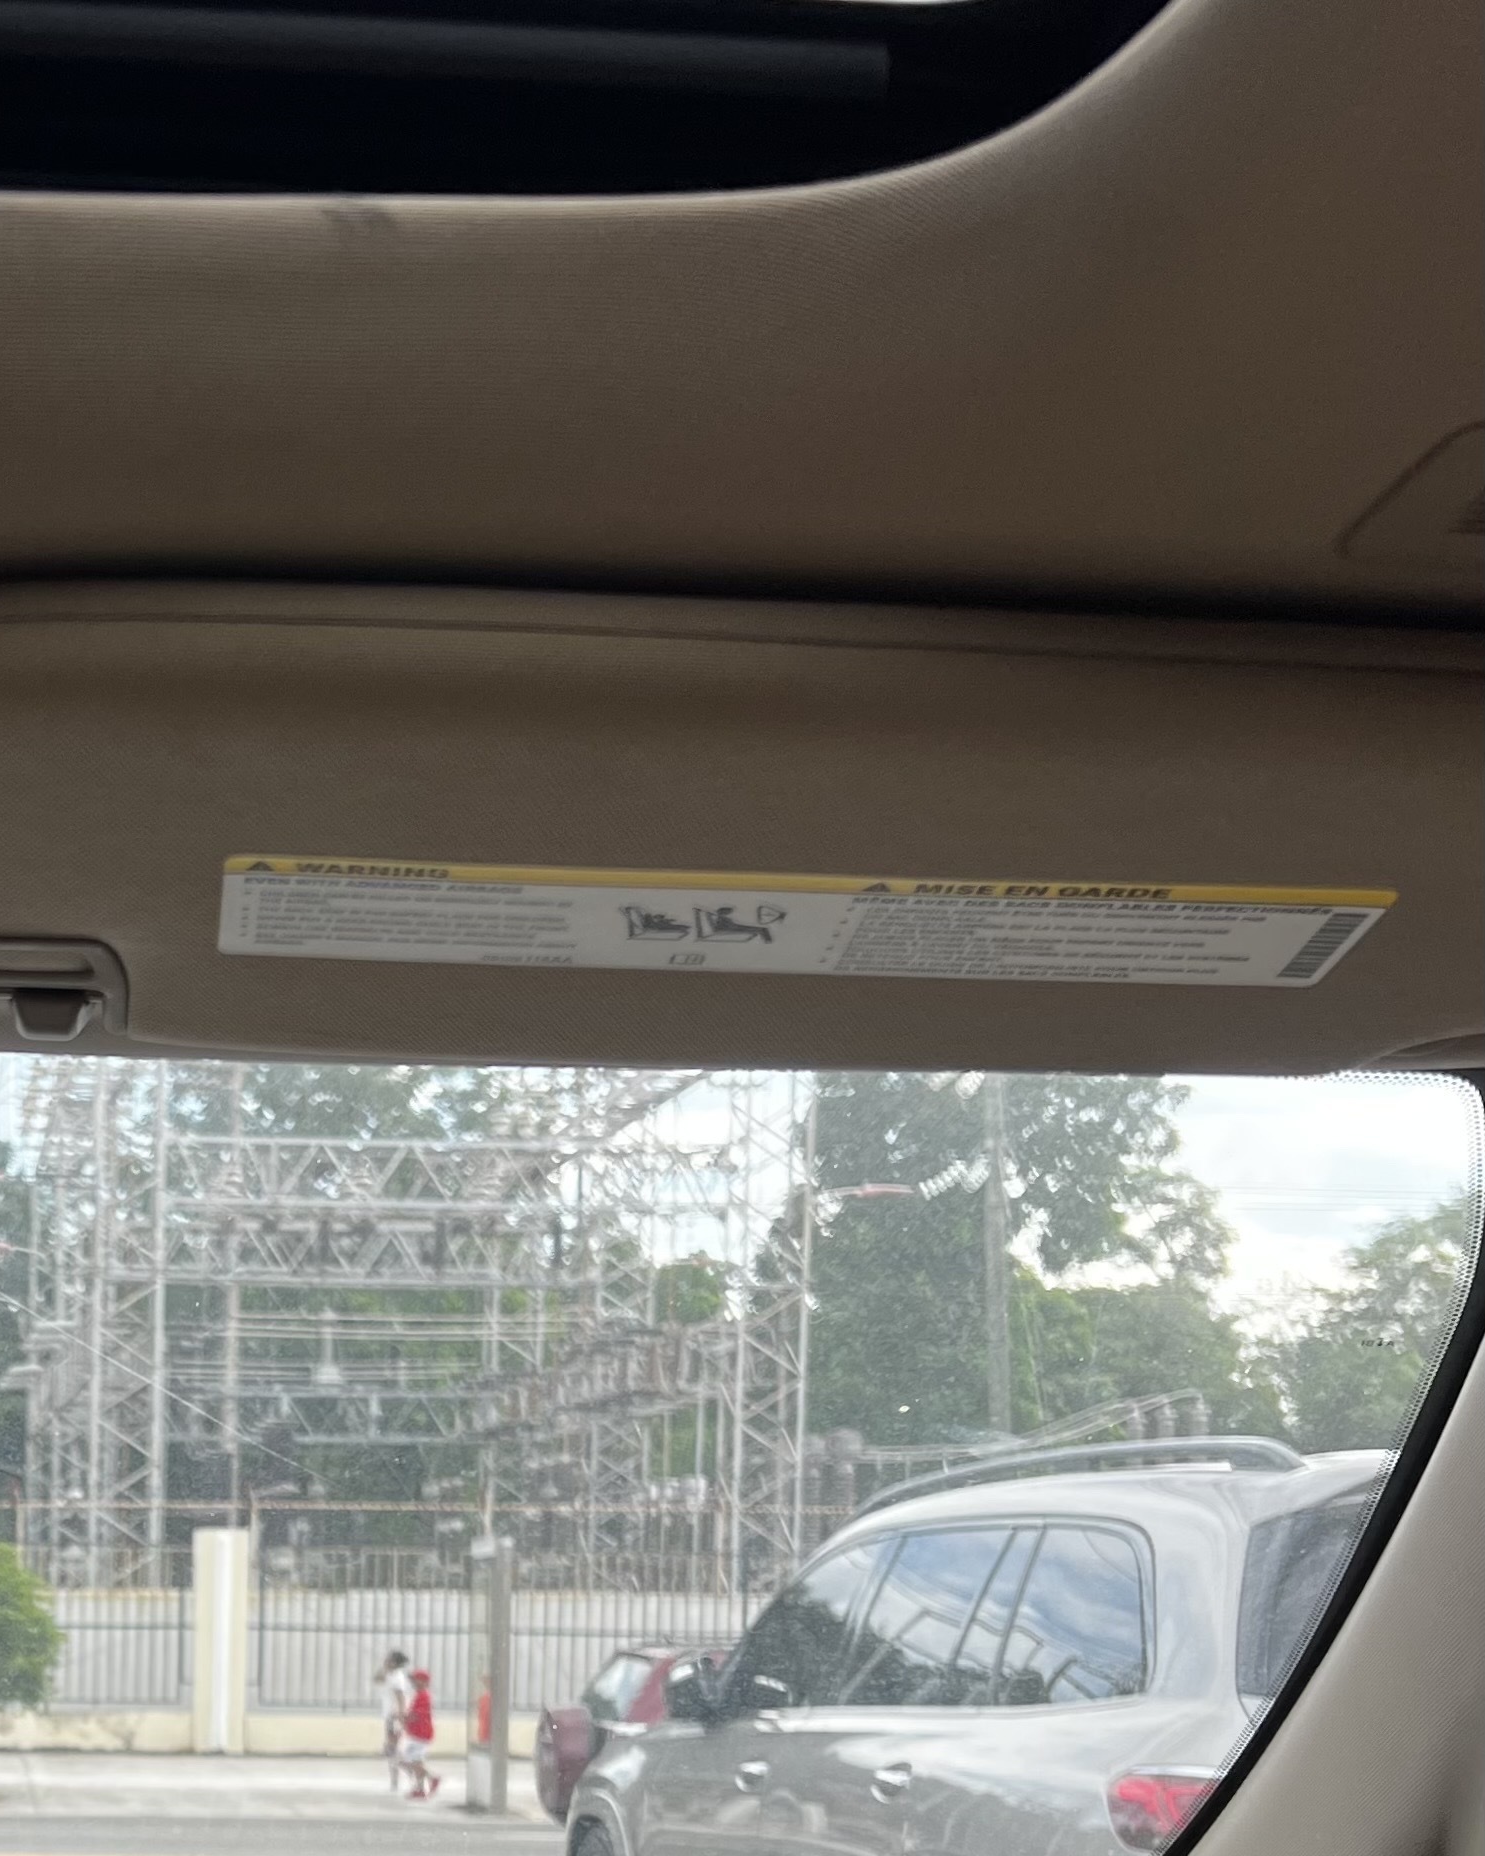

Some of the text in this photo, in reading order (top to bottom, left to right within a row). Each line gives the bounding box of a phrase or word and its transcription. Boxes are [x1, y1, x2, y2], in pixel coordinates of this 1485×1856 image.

[296, 862, 449, 879] WARNING
[914, 884, 1172, 900] MISE EN GARDE
